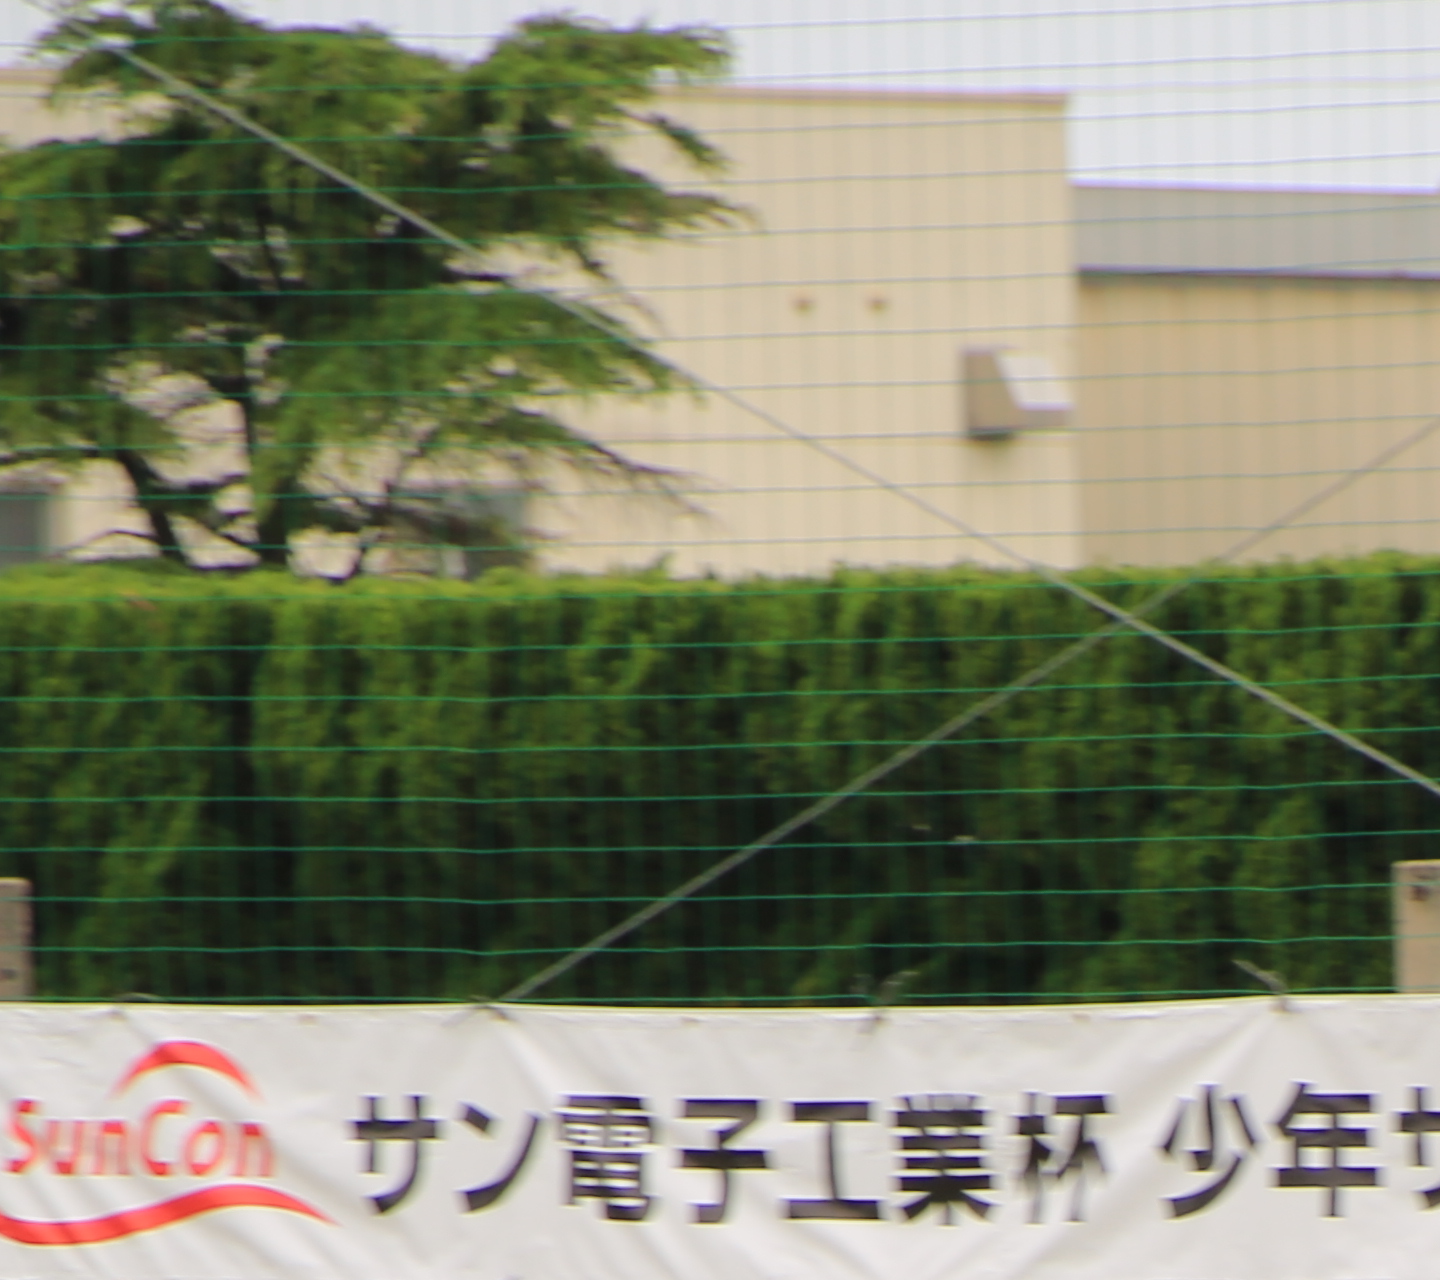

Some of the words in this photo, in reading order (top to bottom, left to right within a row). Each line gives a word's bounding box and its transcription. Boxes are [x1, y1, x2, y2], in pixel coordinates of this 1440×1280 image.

[0, 1099, 277, 1178] SunCon
[347, 1093, 1116, 1226] サン電子工業杯
